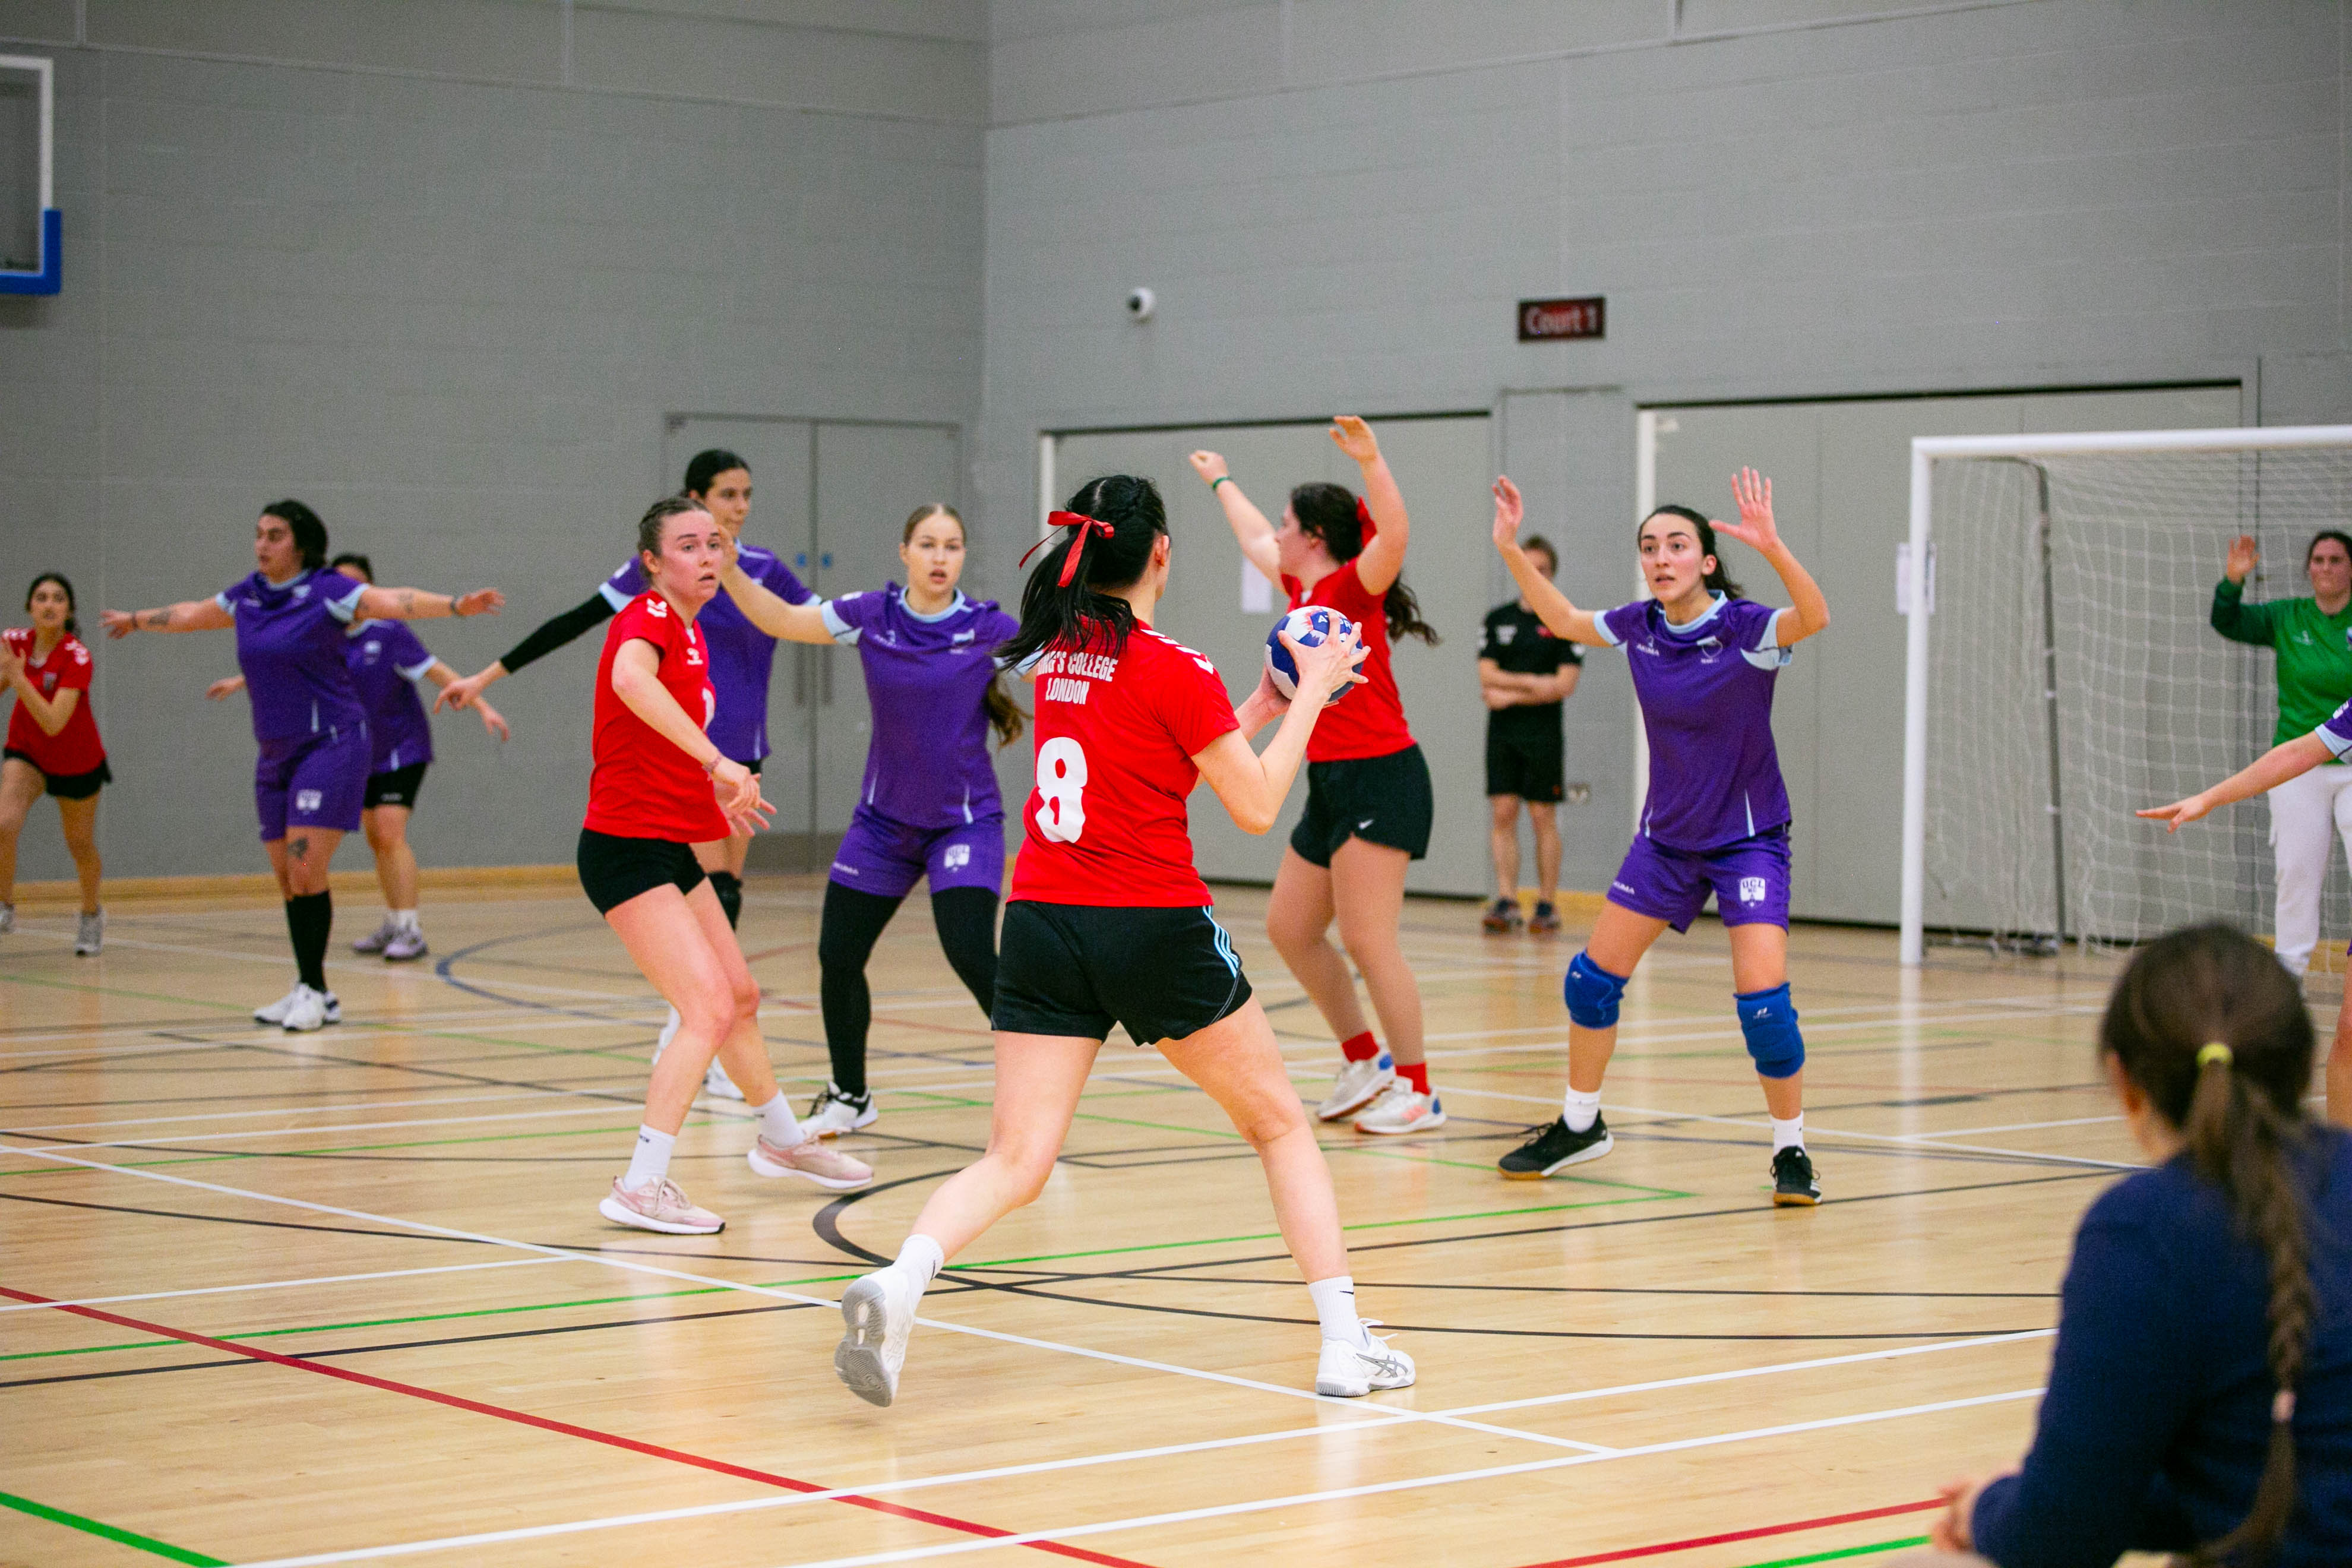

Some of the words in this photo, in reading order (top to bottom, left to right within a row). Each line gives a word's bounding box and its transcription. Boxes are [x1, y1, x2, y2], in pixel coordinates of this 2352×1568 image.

[1525, 305, 1581, 334] Court
[1587, 304, 1597, 333] 1
[1067, 652, 1118, 682] COLLEGE
[1045, 678, 1090, 705] LONDON
[1036, 736, 1088, 843] 8
[1743, 880, 1763, 889] UCL
